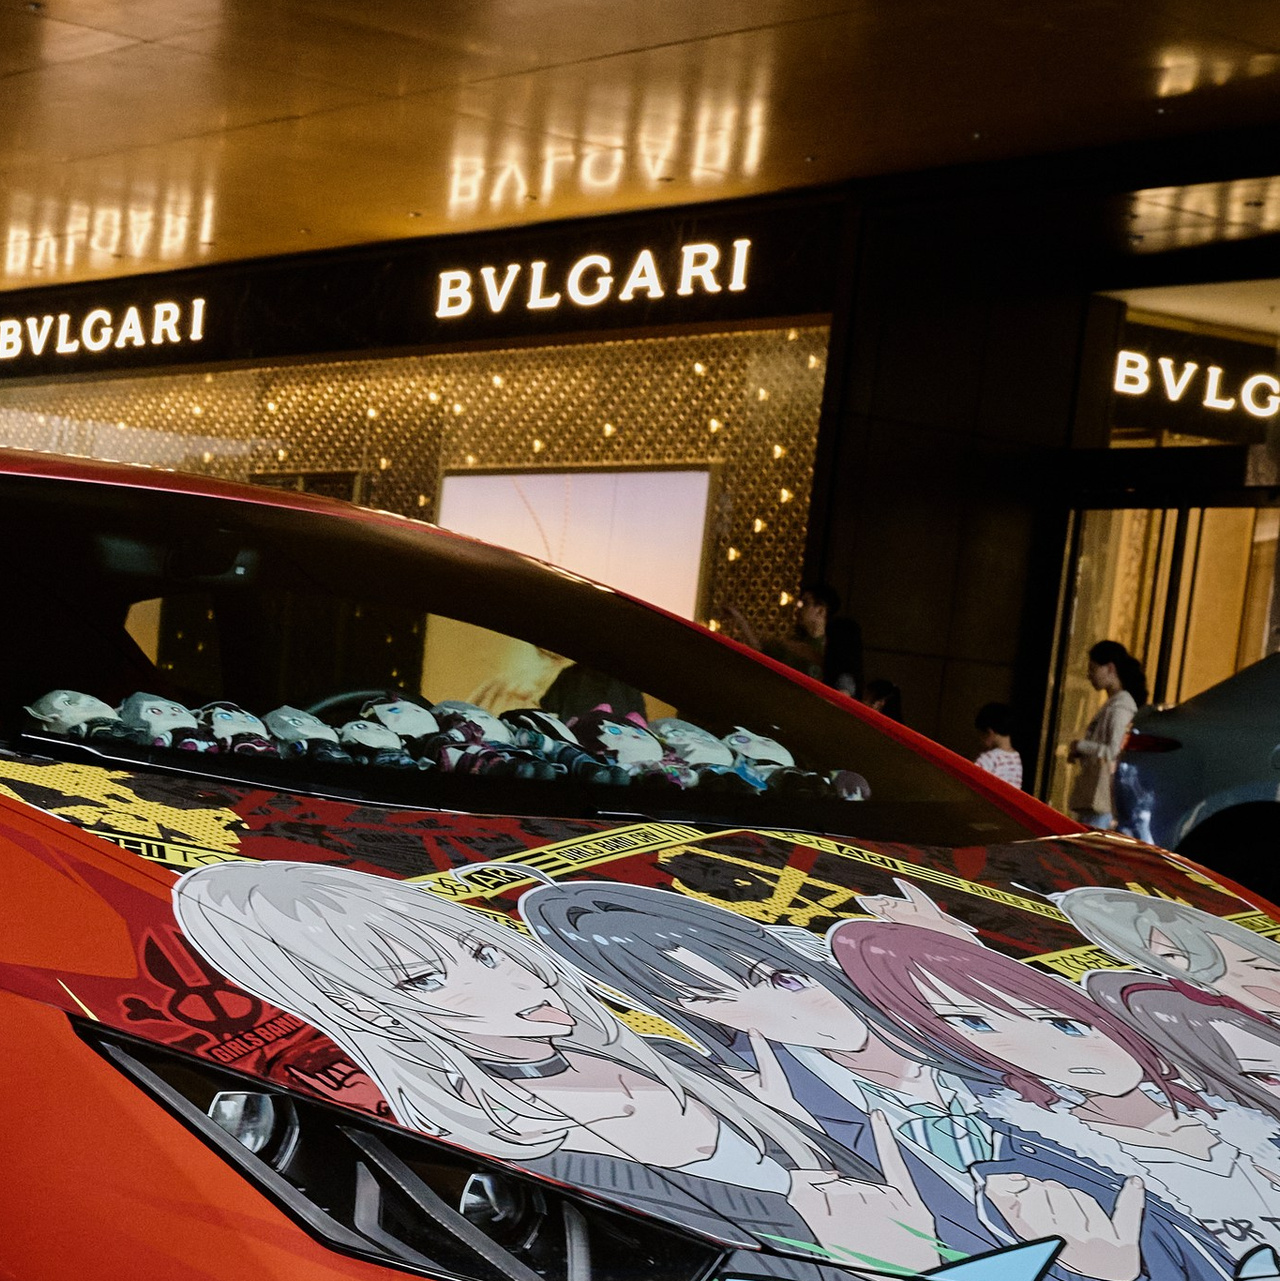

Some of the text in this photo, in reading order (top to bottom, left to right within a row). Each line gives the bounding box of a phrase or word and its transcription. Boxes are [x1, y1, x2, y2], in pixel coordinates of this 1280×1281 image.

[435, 237, 752, 320] BVLGARI
[1113, 349, 1280, 418] BVLG
[557, 829, 665, 862] GIRLS BAND CRY
[214, 1028, 263, 1062] GIRLS
